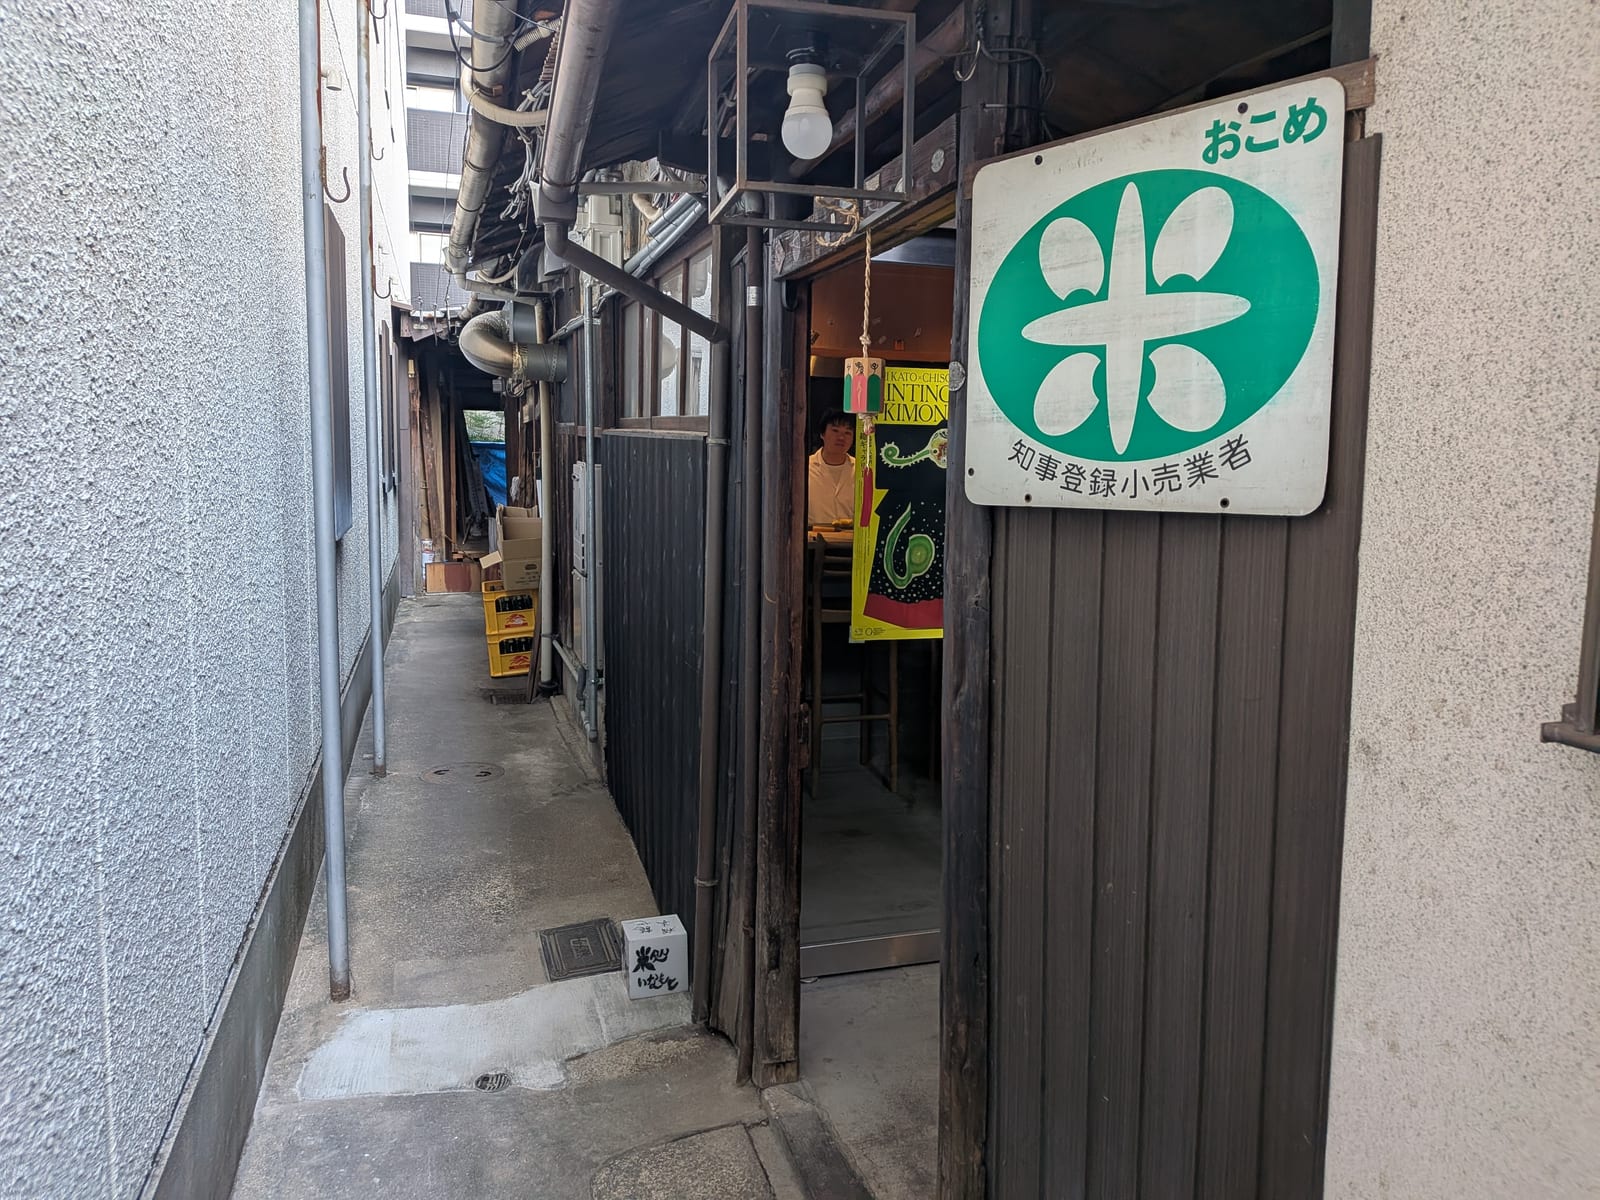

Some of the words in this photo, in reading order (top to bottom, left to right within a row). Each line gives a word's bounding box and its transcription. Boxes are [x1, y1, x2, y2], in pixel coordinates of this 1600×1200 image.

[1202, 97, 1328, 164] おこめ
[884, 403, 948, 422] KIMON
[1007, 433, 1253, 499] 知事登録小売業者
